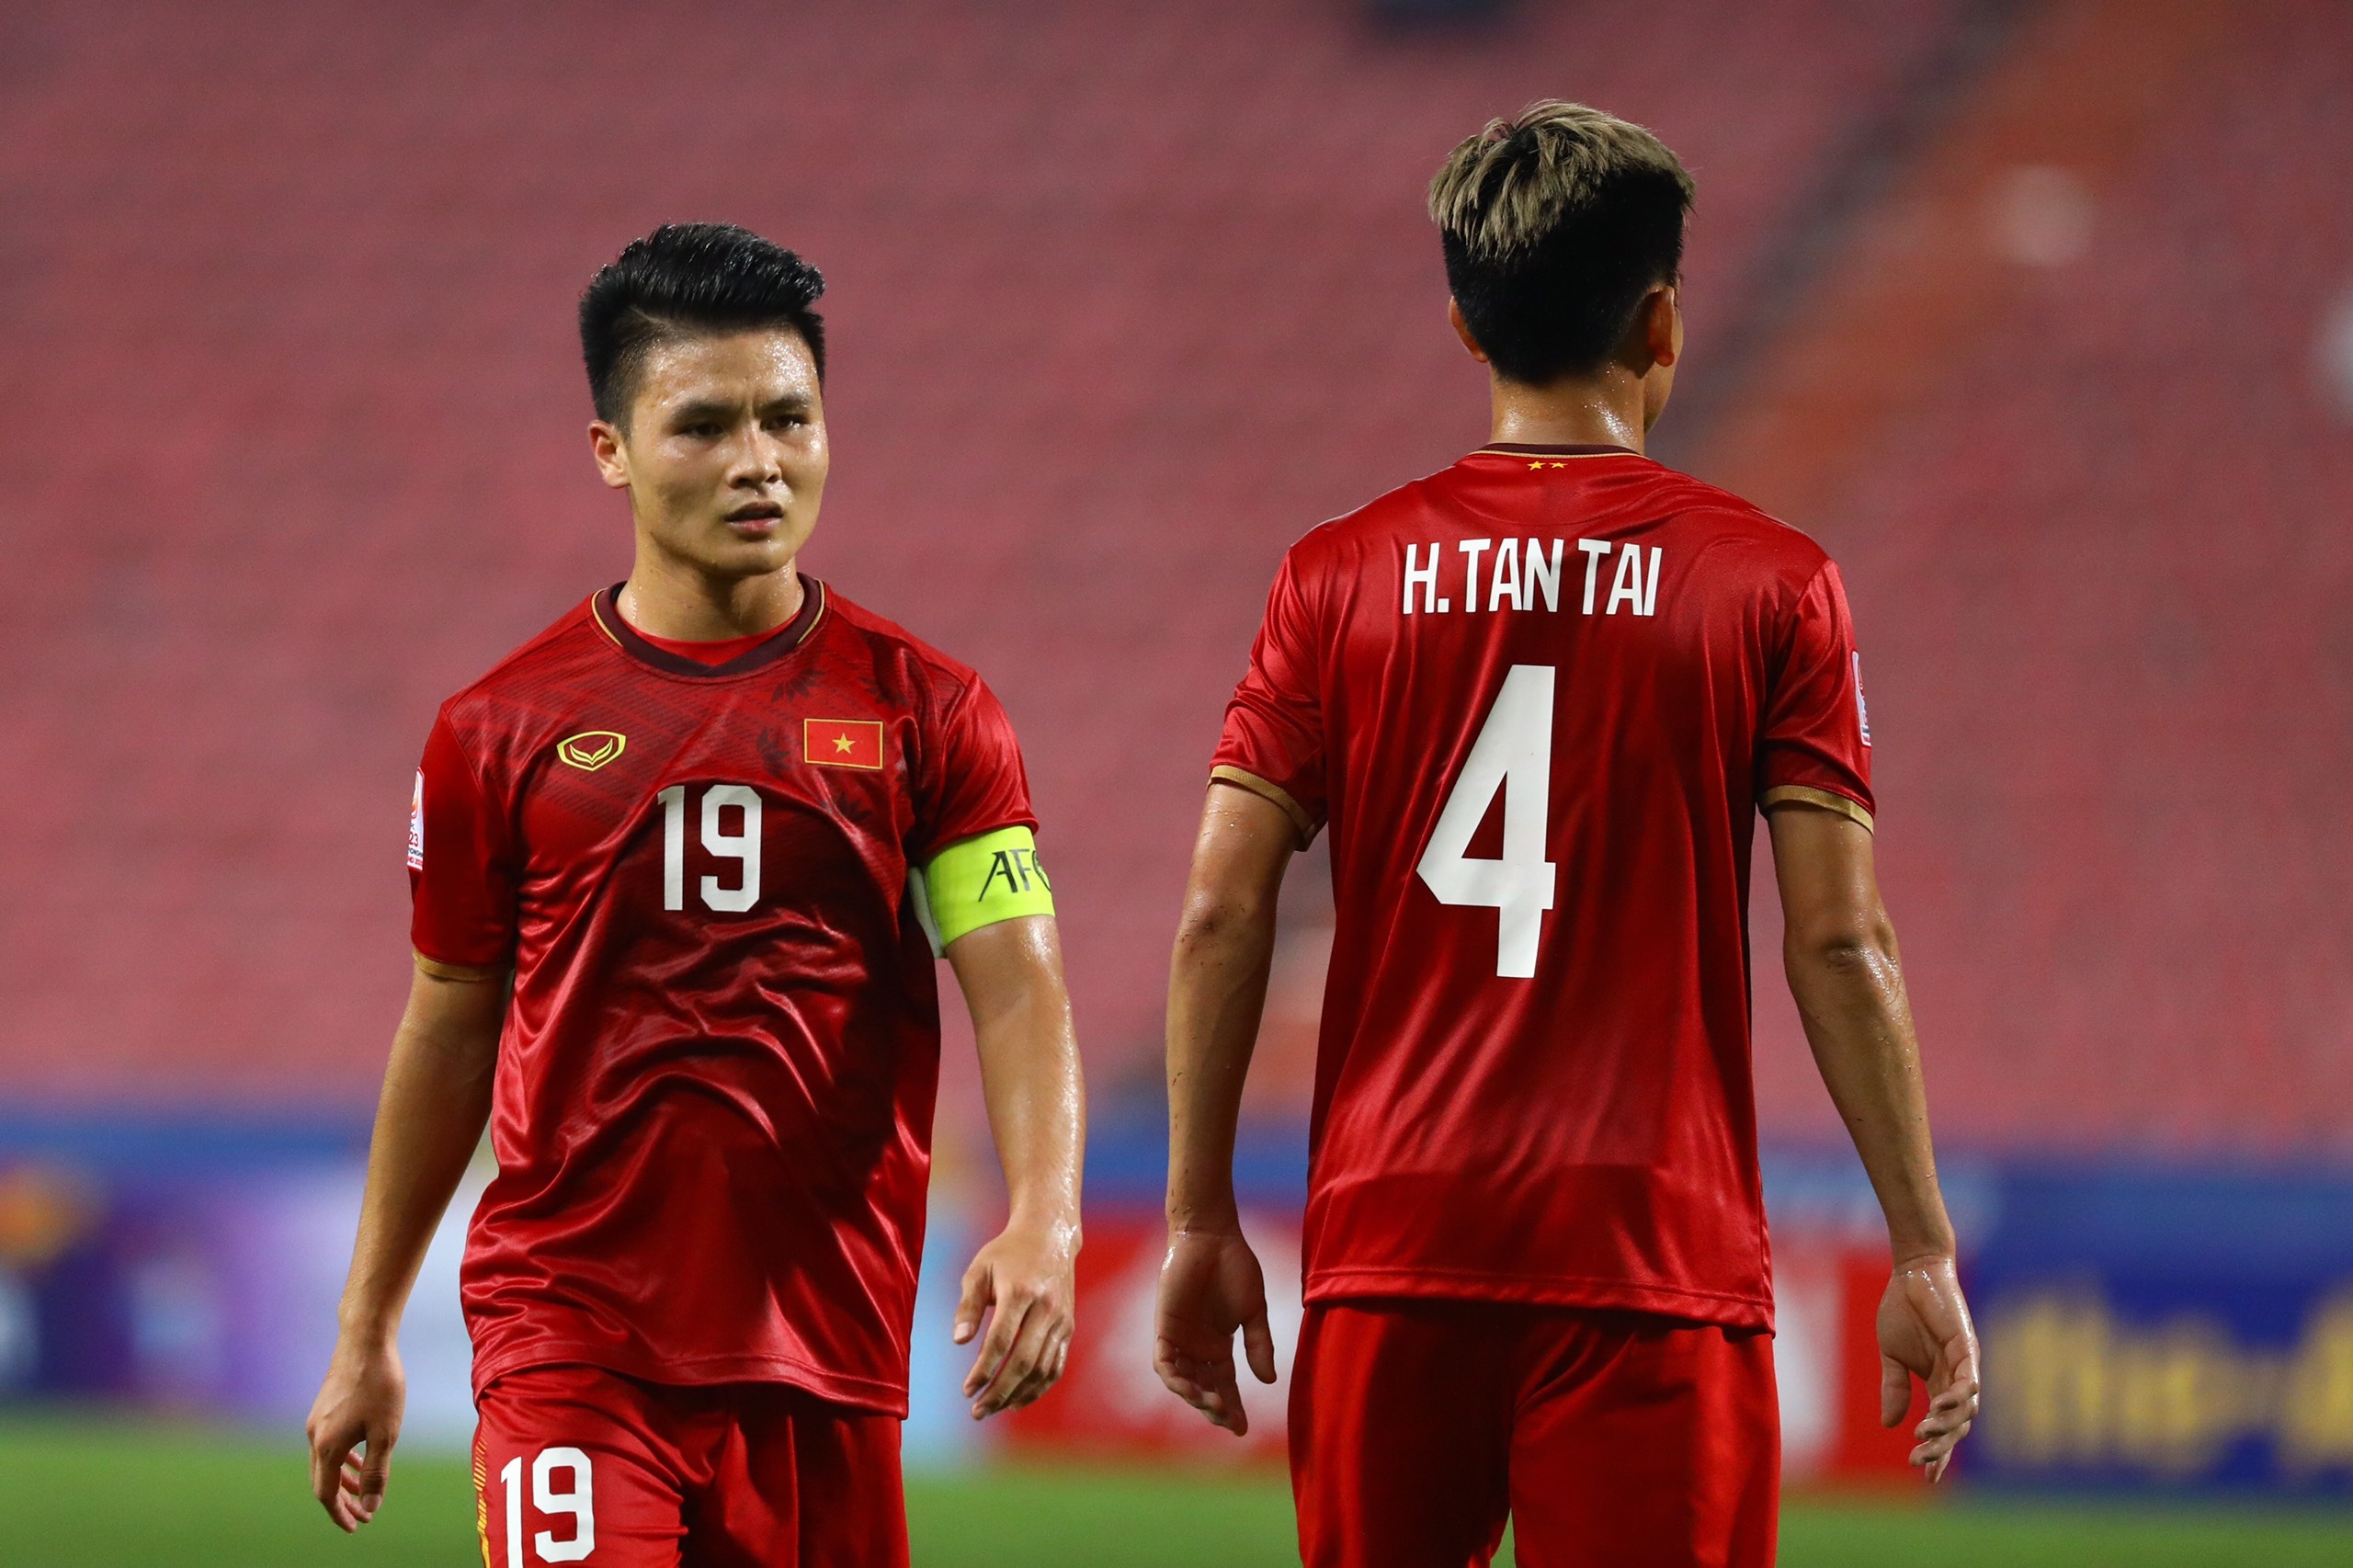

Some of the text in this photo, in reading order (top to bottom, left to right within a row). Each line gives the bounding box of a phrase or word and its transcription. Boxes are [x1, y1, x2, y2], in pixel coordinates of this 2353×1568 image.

[1578, 538, 1663, 616] TAI
[657, 784, 762, 913] 19
[1415, 664, 1556, 979] 4
[500, 1446, 596, 1568] 19
